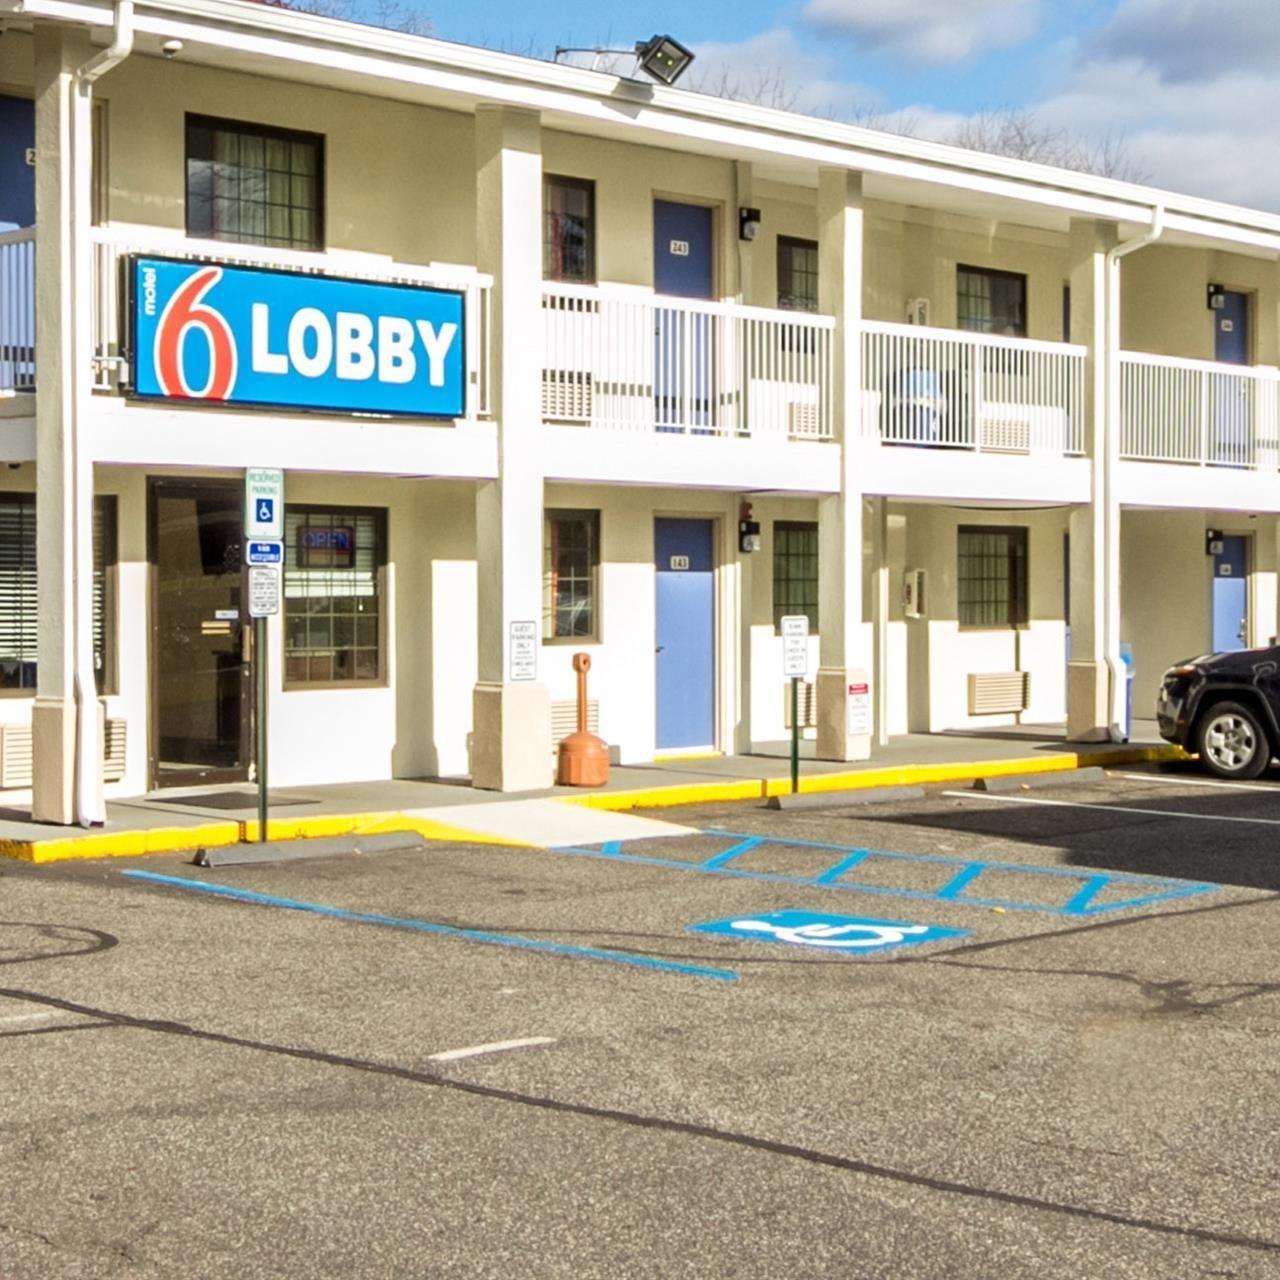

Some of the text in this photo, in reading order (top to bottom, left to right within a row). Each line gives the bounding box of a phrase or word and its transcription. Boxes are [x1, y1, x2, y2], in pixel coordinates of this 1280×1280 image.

[141, 267, 157, 316] motel
[153, 266, 238, 401] 6
[252, 302, 458, 387] LOBBY
[302, 531, 350, 548] OPEN
